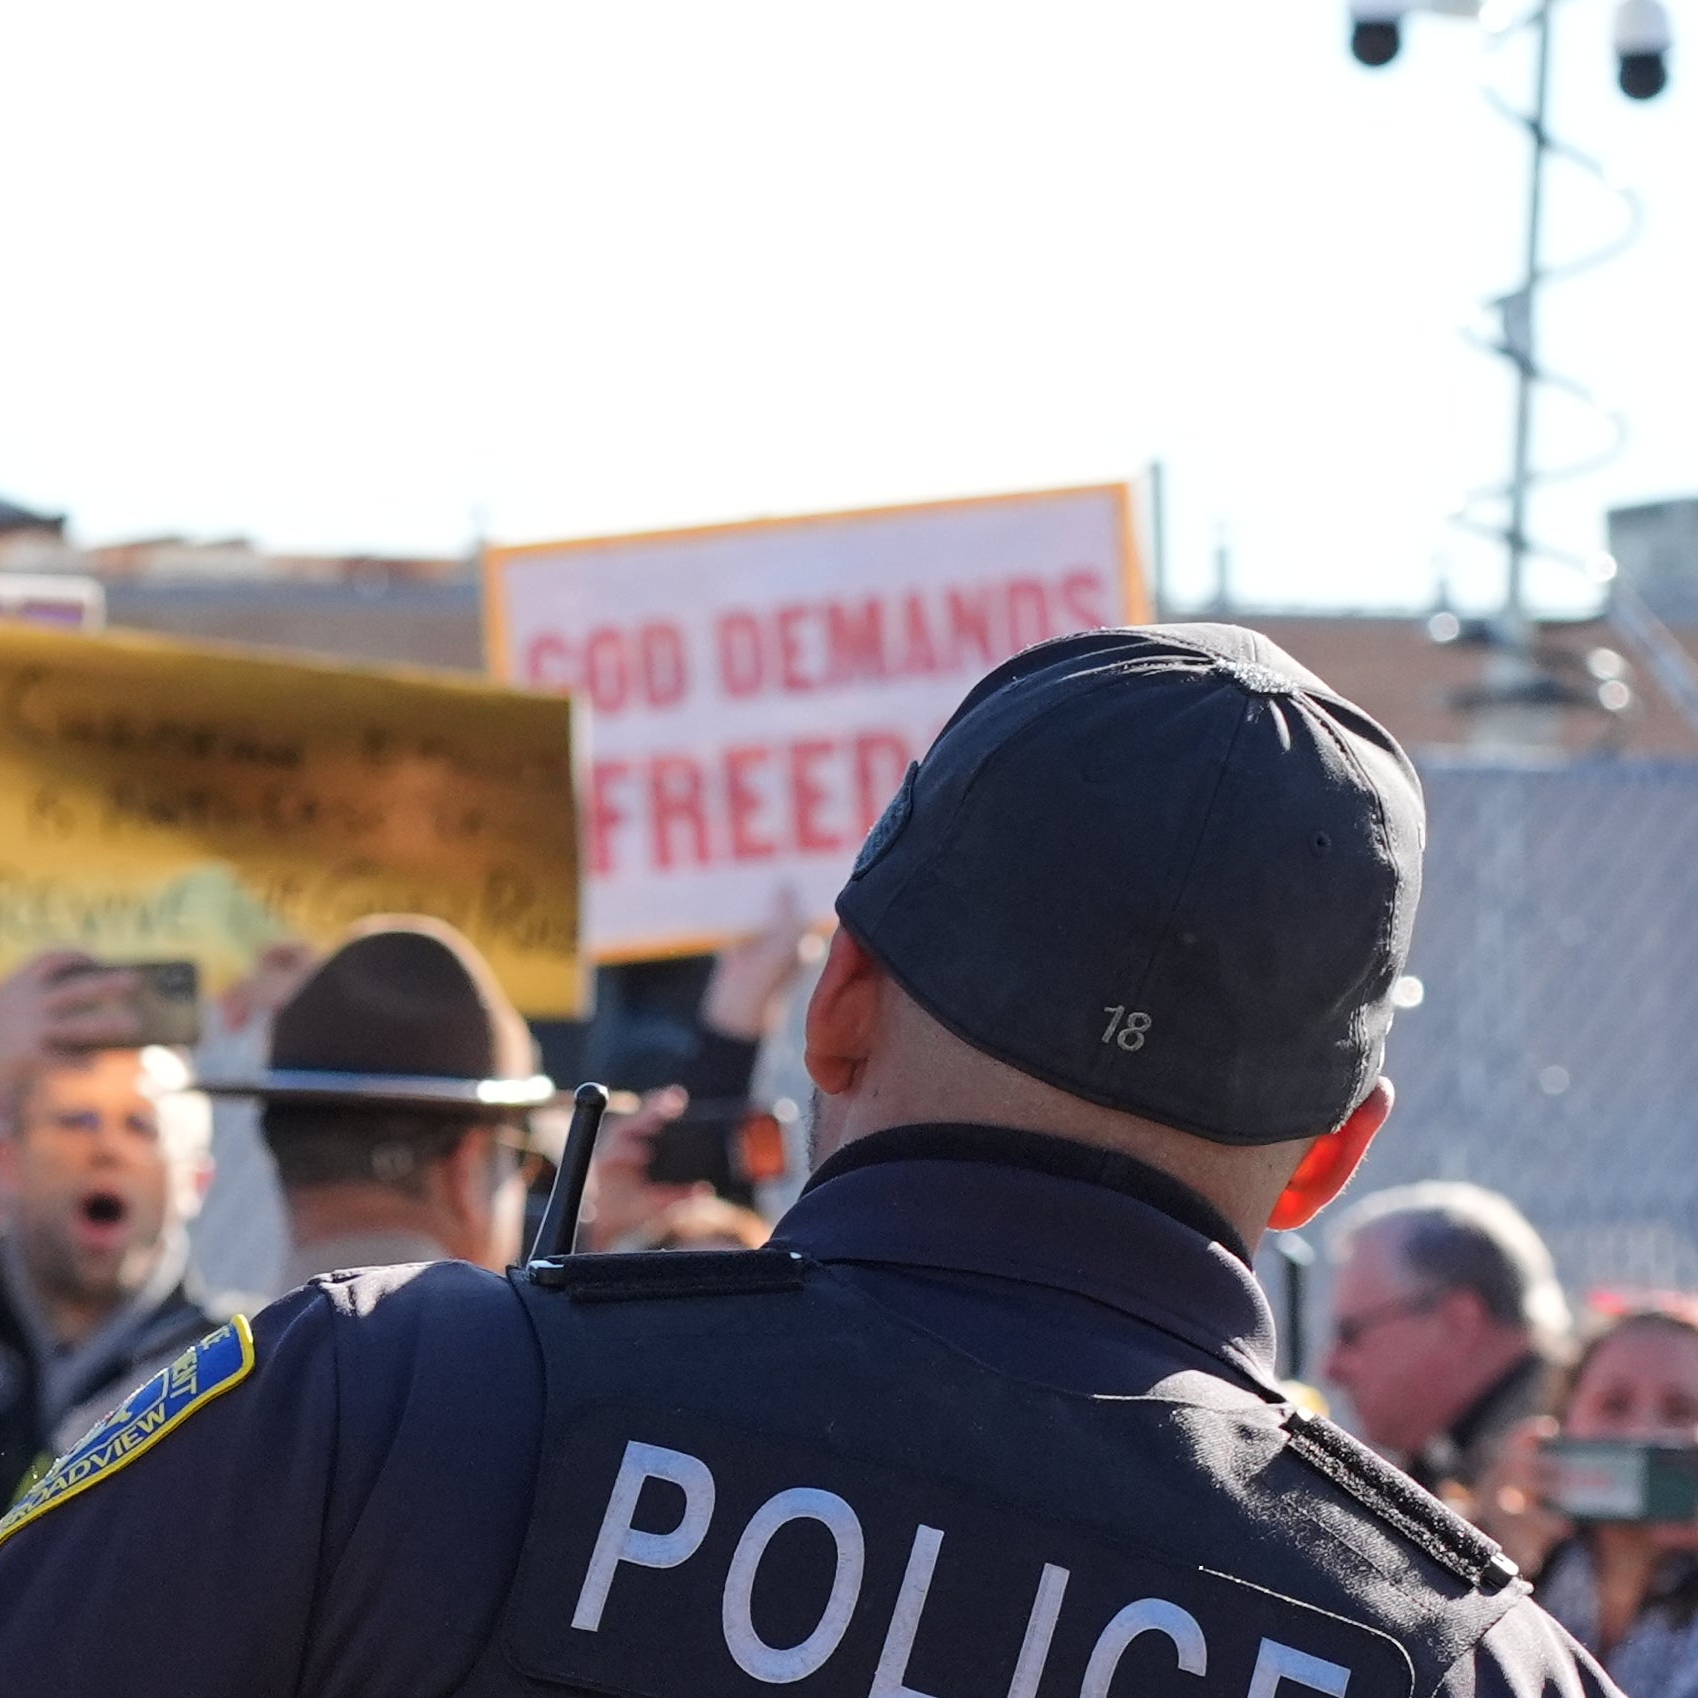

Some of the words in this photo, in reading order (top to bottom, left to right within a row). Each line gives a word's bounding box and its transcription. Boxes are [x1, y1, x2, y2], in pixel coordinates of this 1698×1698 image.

[525, 618, 688, 716] GOD
[716, 566, 1107, 698] DEMANDS
[585, 730, 935, 876] FREED
[1101, 1005, 1153, 1052] 18
[3, 1402, 167, 1527] ROADVIEW
